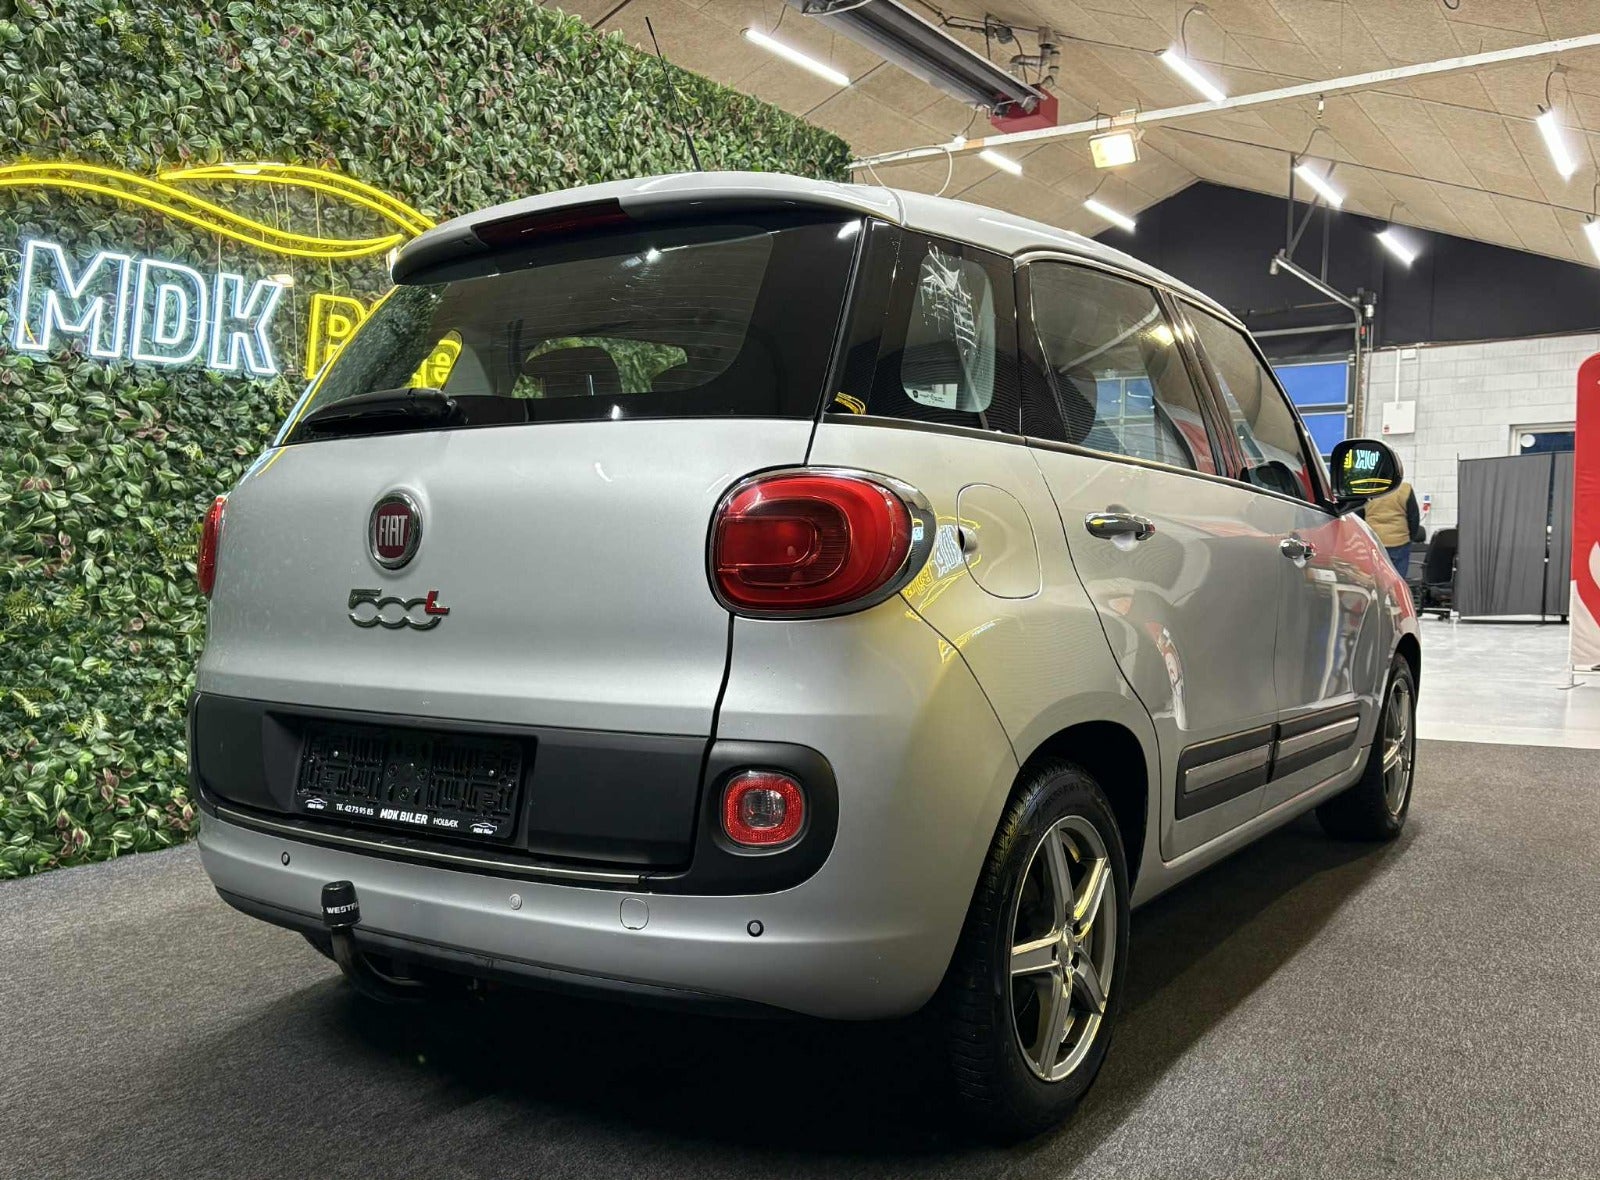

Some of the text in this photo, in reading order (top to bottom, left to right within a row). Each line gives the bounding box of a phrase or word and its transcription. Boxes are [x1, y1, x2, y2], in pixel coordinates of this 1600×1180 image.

[15, 239, 283, 375] MDK
[378, 514, 408, 547] FIAT
[348, 588, 450, 631] 500L
[380, 808, 399, 820] MDK
[400, 811, 429, 825] BILER
